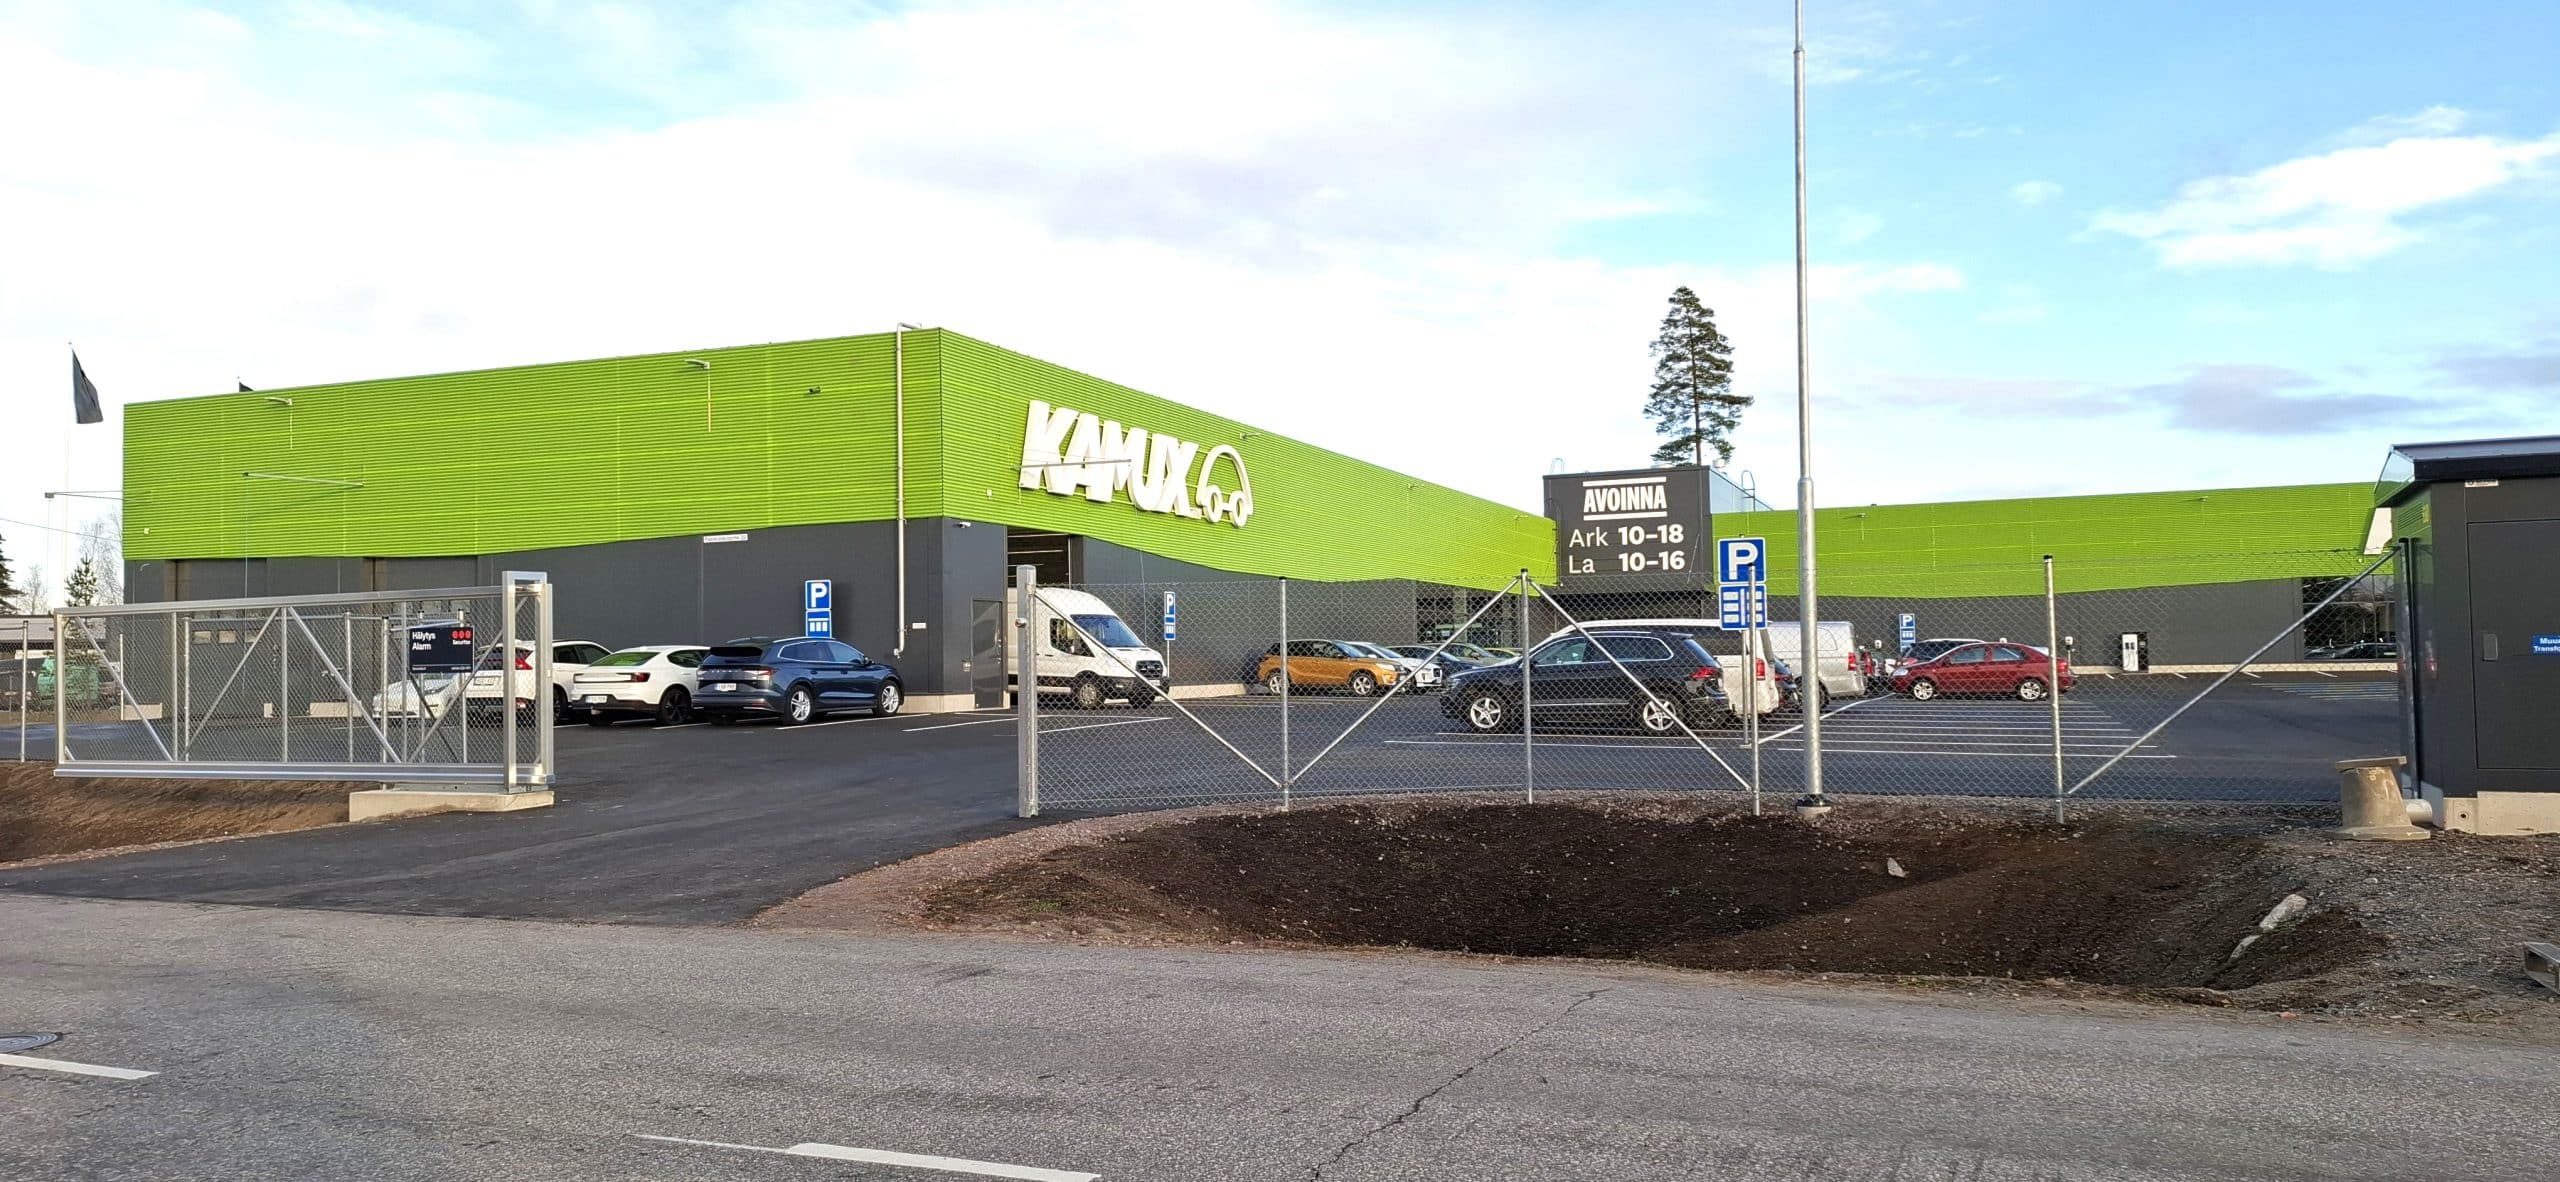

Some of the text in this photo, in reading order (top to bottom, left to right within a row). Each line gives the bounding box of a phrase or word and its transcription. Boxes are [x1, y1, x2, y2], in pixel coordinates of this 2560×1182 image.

[1019, 399, 1201, 519] KAMUX
[1583, 485, 1667, 513] AVOINNA
[1569, 527, 1609, 548] Ark
[1569, 555, 1595, 574] La
[1727, 542, 1758, 580] P
[811, 583, 827, 608] P
[1166, 593, 1174, 614] P
[1902, 615, 1913, 627] P
[412, 642, 432, 650] Alarm
